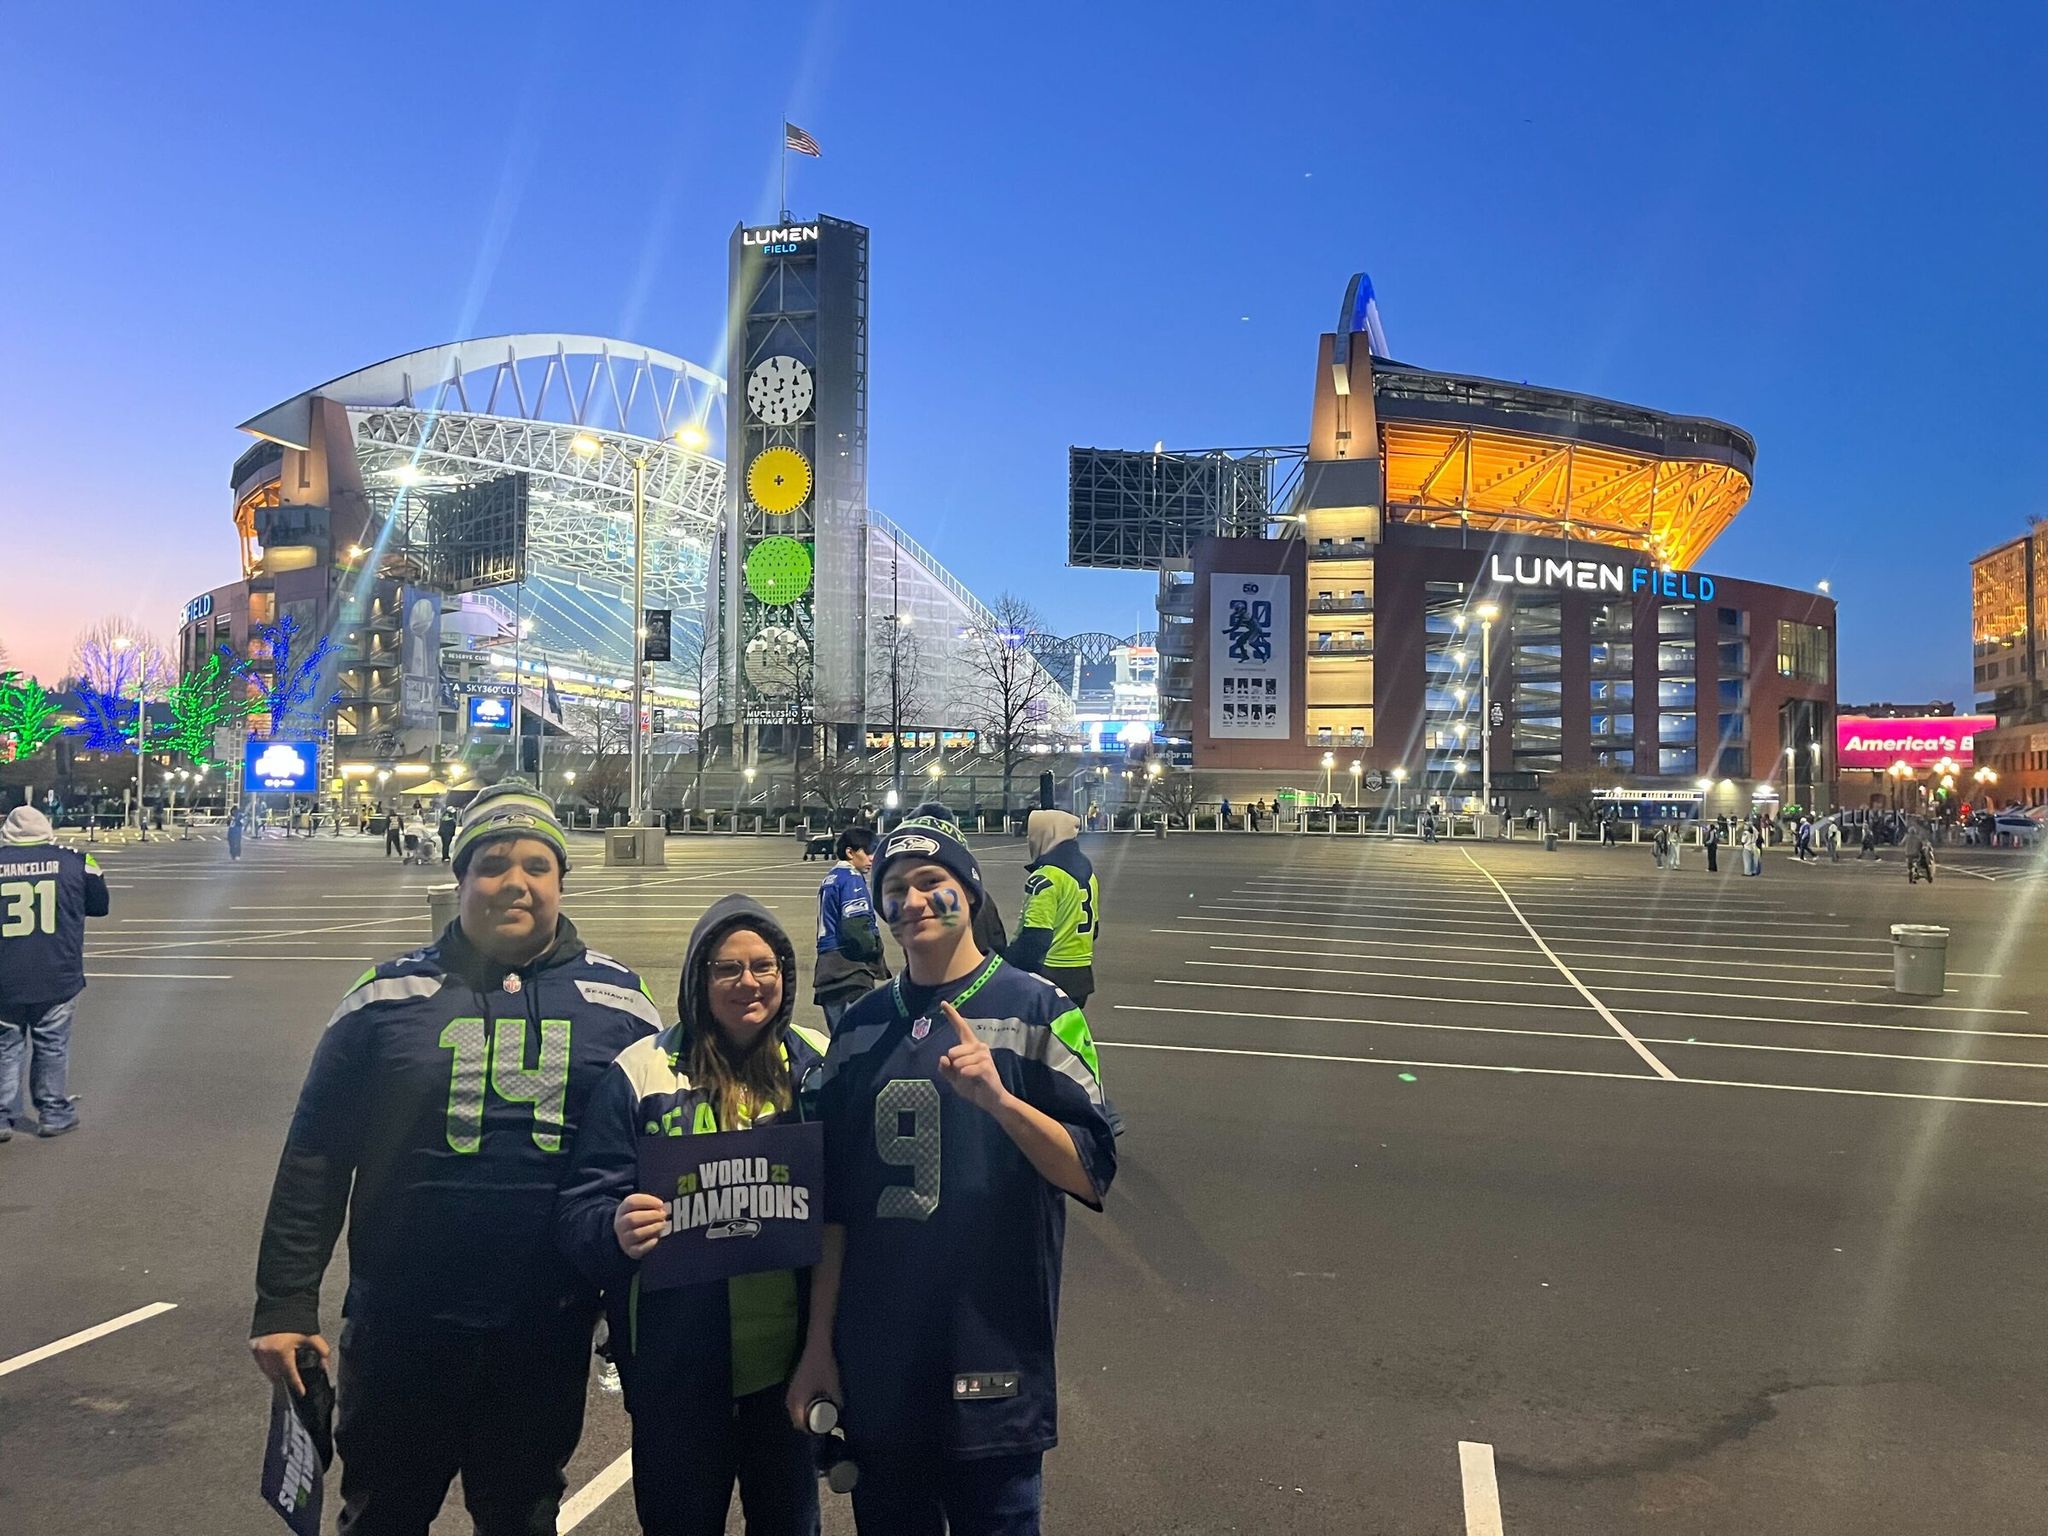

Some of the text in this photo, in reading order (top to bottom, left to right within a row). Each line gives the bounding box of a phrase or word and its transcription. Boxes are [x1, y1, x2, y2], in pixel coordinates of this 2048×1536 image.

[743, 225, 818, 246] LUMEN
[764, 243, 797, 254] FIELD
[1491, 553, 1716, 601] LUMEN FIELD
[1243, 584, 1259, 593] 50
[187, 594, 211, 622] FIELD
[743, 717, 813, 725] HERITAGE PLZA
[1845, 736, 1956, 751] America's
[0, 861, 59, 877] CHANCELLOR
[1, 880, 56, 937] 31
[585, 987, 635, 1003] SEAHAWKS
[438, 1017, 572, 1154] 14
[875, 1079, 941, 1221] 9
[699, 1157, 769, 1189] WORLD
[771, 1164, 790, 1183] 25
